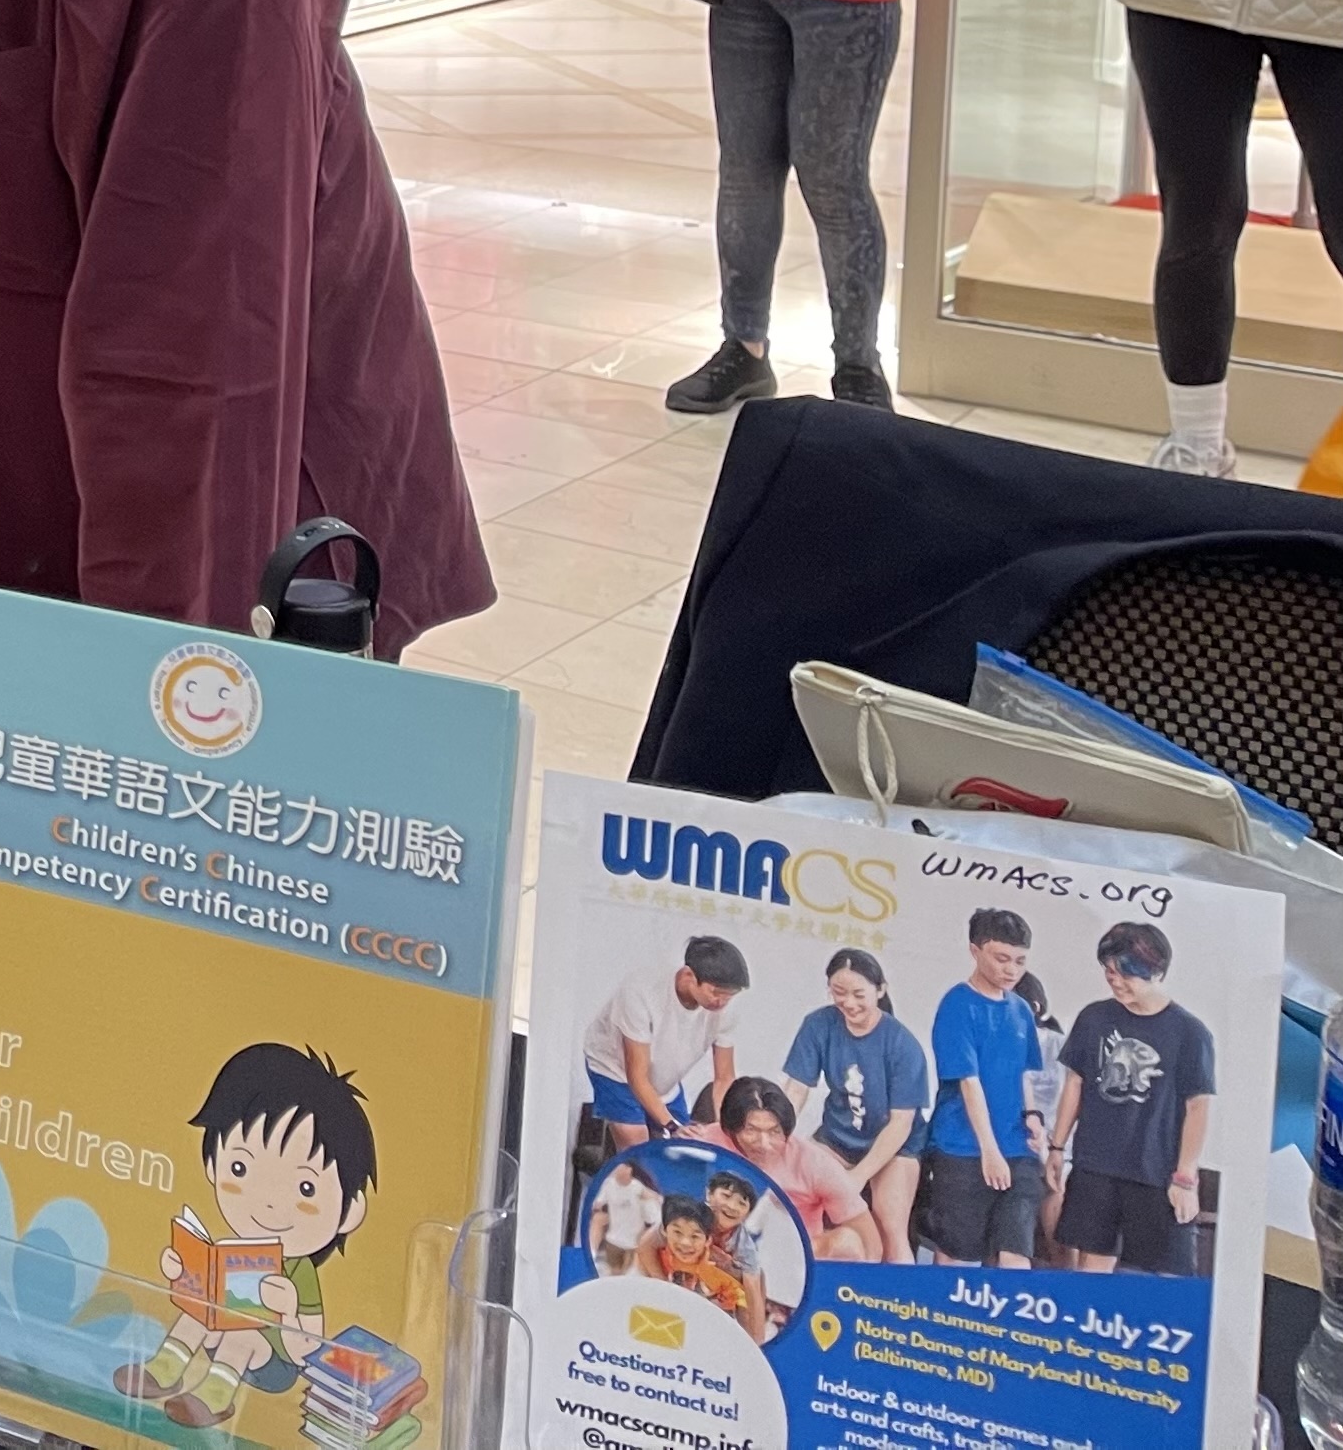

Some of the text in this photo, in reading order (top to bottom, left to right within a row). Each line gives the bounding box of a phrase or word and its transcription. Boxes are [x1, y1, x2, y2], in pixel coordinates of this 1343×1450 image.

[52, 816, 329, 906] Children's Chinese
[139, 875, 330, 945] Certification
[339, 922, 448, 977] (CCCC)
[837, 1285, 1191, 1383] Overnight summer camp for ages 8-18
[949, 1278, 1009, 1318] July
[1014, 1292, 1058, 1325] 20
[1079, 1308, 1142, 1350] July
[1147, 1324, 1194, 1354] 27
[568, 1361, 740, 1421] free to contact us!
[578, 1340, 732, 1394] Questions? Feel
[854, 1341, 994, 1392] (Baltimore, MD)
[855, 1318, 1182, 1414] Notre Dame of Maryland University
[811, 1399, 950, 1445] arts and crafts,
[817, 1374, 880, 1407] Indoor
[882, 1392, 900, 1410] &
[902, 1397, 980, 1430] outdoor
[982, 1420, 1049, 1449] games
